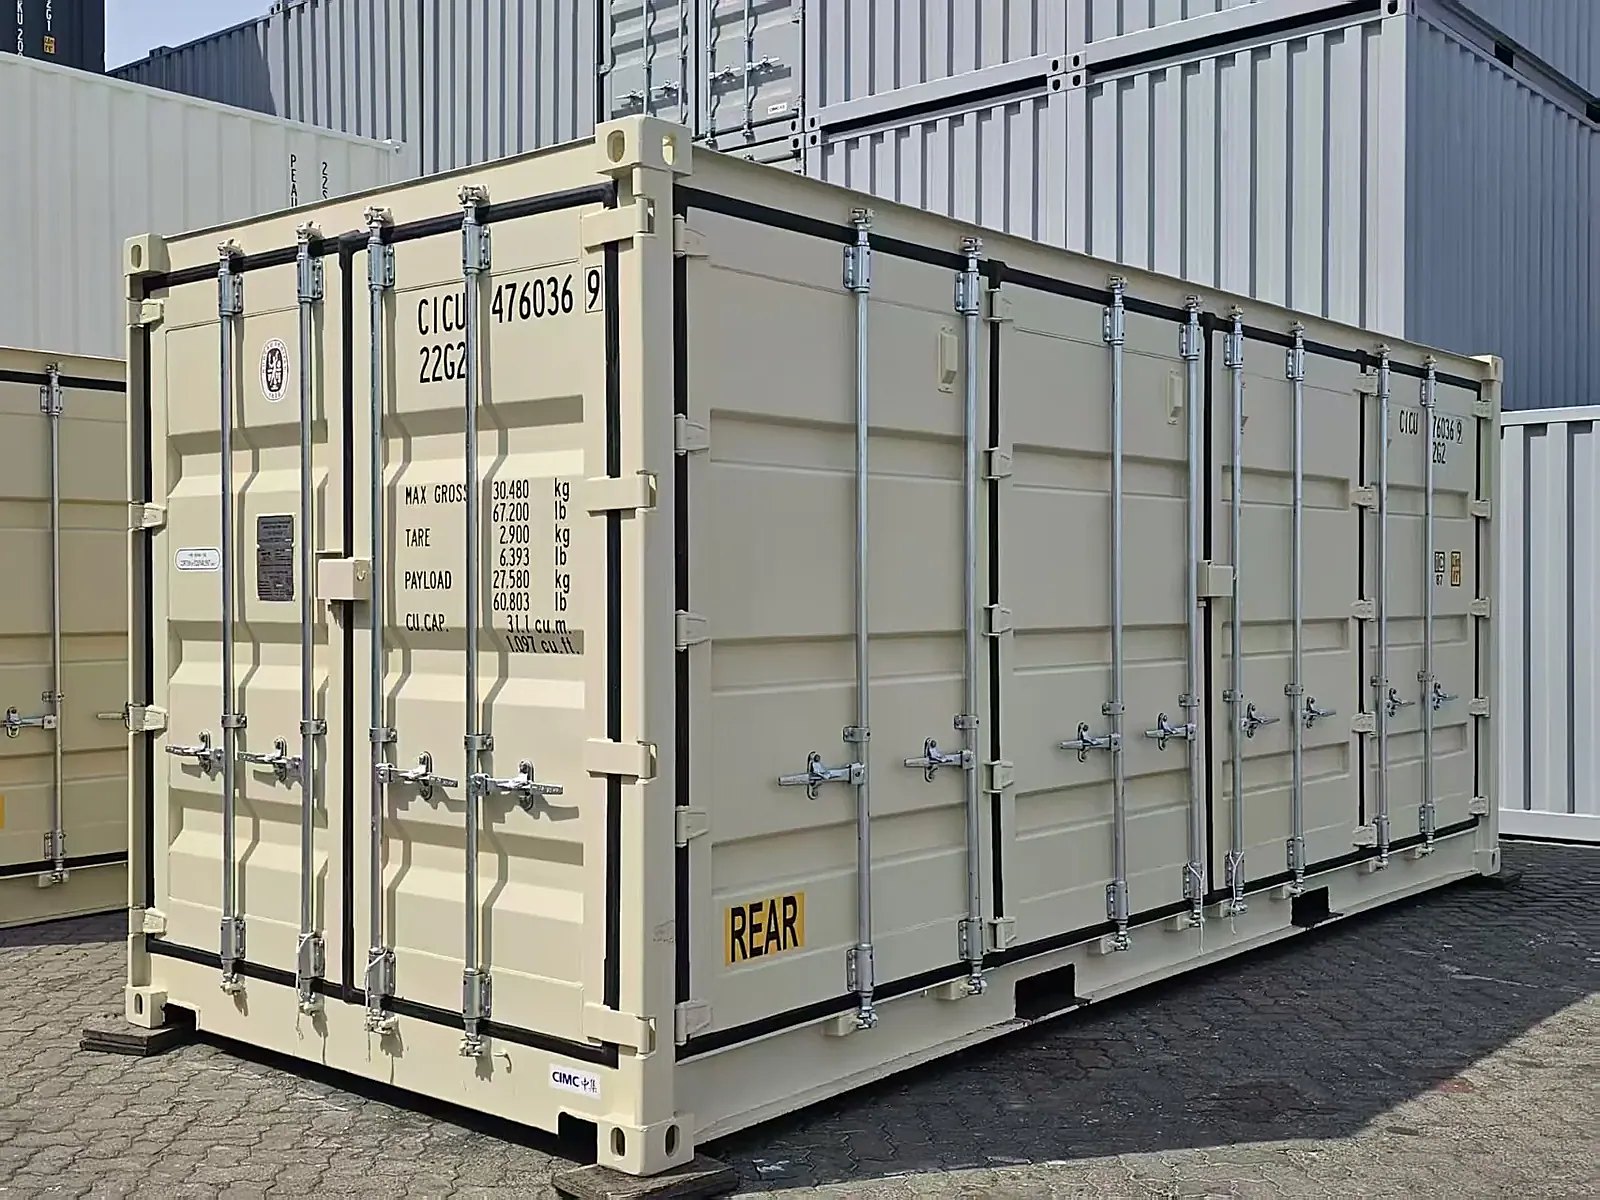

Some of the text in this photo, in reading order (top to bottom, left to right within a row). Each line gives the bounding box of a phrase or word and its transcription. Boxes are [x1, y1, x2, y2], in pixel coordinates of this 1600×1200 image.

[492, 274, 573, 324] 476036
[587, 269, 601, 310] 9
[1399, 409, 1419, 435] CICU
[1432, 415, 1455, 441] 76036
[405, 485, 427, 505] MAX
[493, 477, 570, 501] 30.480 kg
[493, 501, 567, 523] 67.200 lb
[405, 528, 431, 547] TARE
[499, 523, 571, 547] 2.900 kg
[499, 546, 567, 567] 6.393 lb
[404, 570, 453, 590] PAYLOAD
[493, 568, 571, 593] 27.580 kg
[493, 592, 567, 612] 60.803 lb
[405, 613, 450, 633] CU.CAP.
[534, 618, 573, 635] cu.m.
[540, 632, 581, 655] cu.ft.
[730, 895, 799, 964] REAR
[551, 1071, 580, 1088] CIMC
